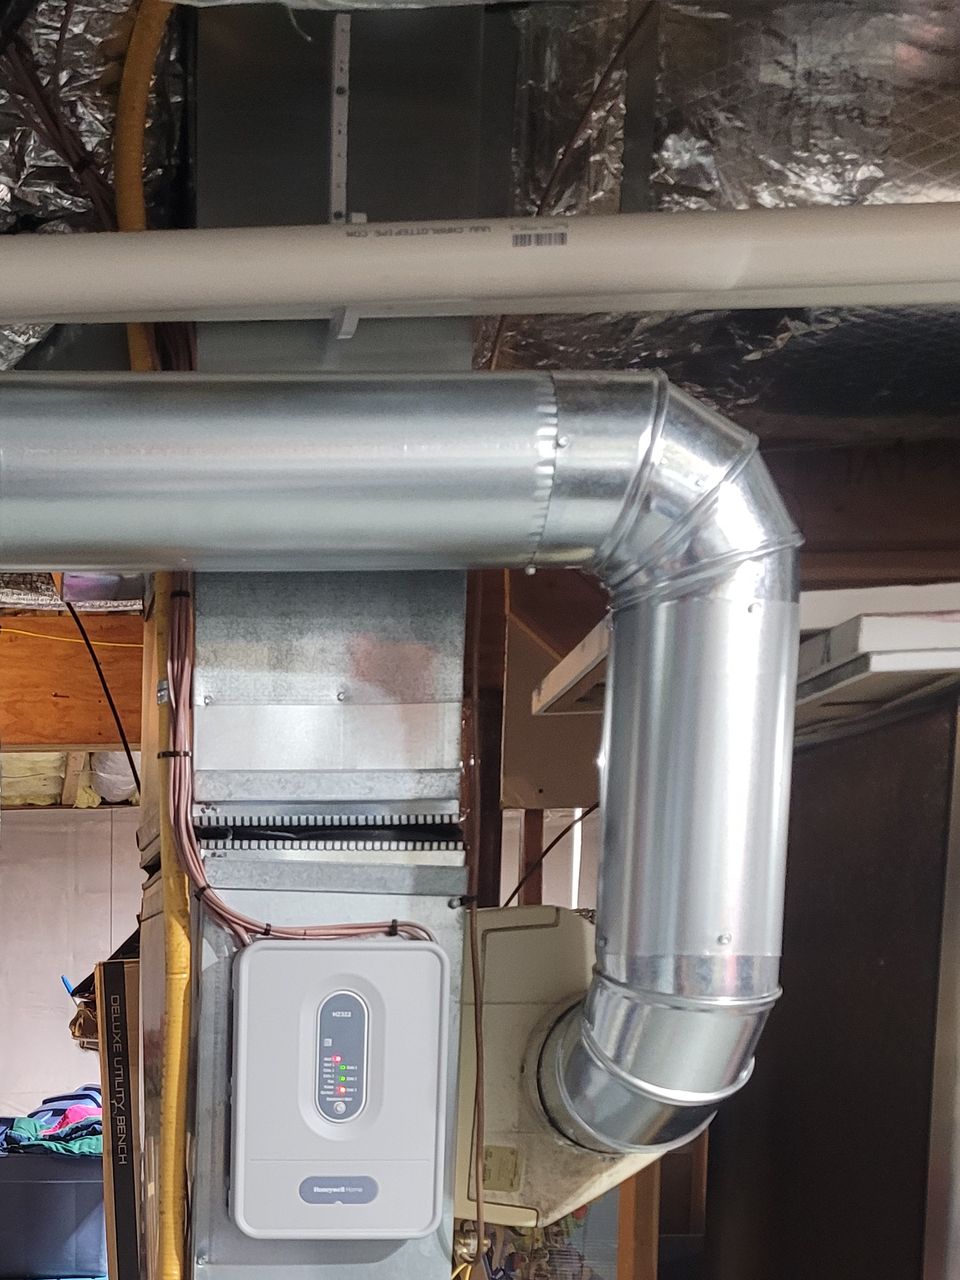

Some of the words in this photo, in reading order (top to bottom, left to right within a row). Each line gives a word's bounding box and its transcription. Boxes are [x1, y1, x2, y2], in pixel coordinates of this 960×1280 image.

[111, 995, 122, 1052] DELUXE
[113, 1057, 126, 1111] UTILITY
[116, 1115, 127, 1165] BENCH
